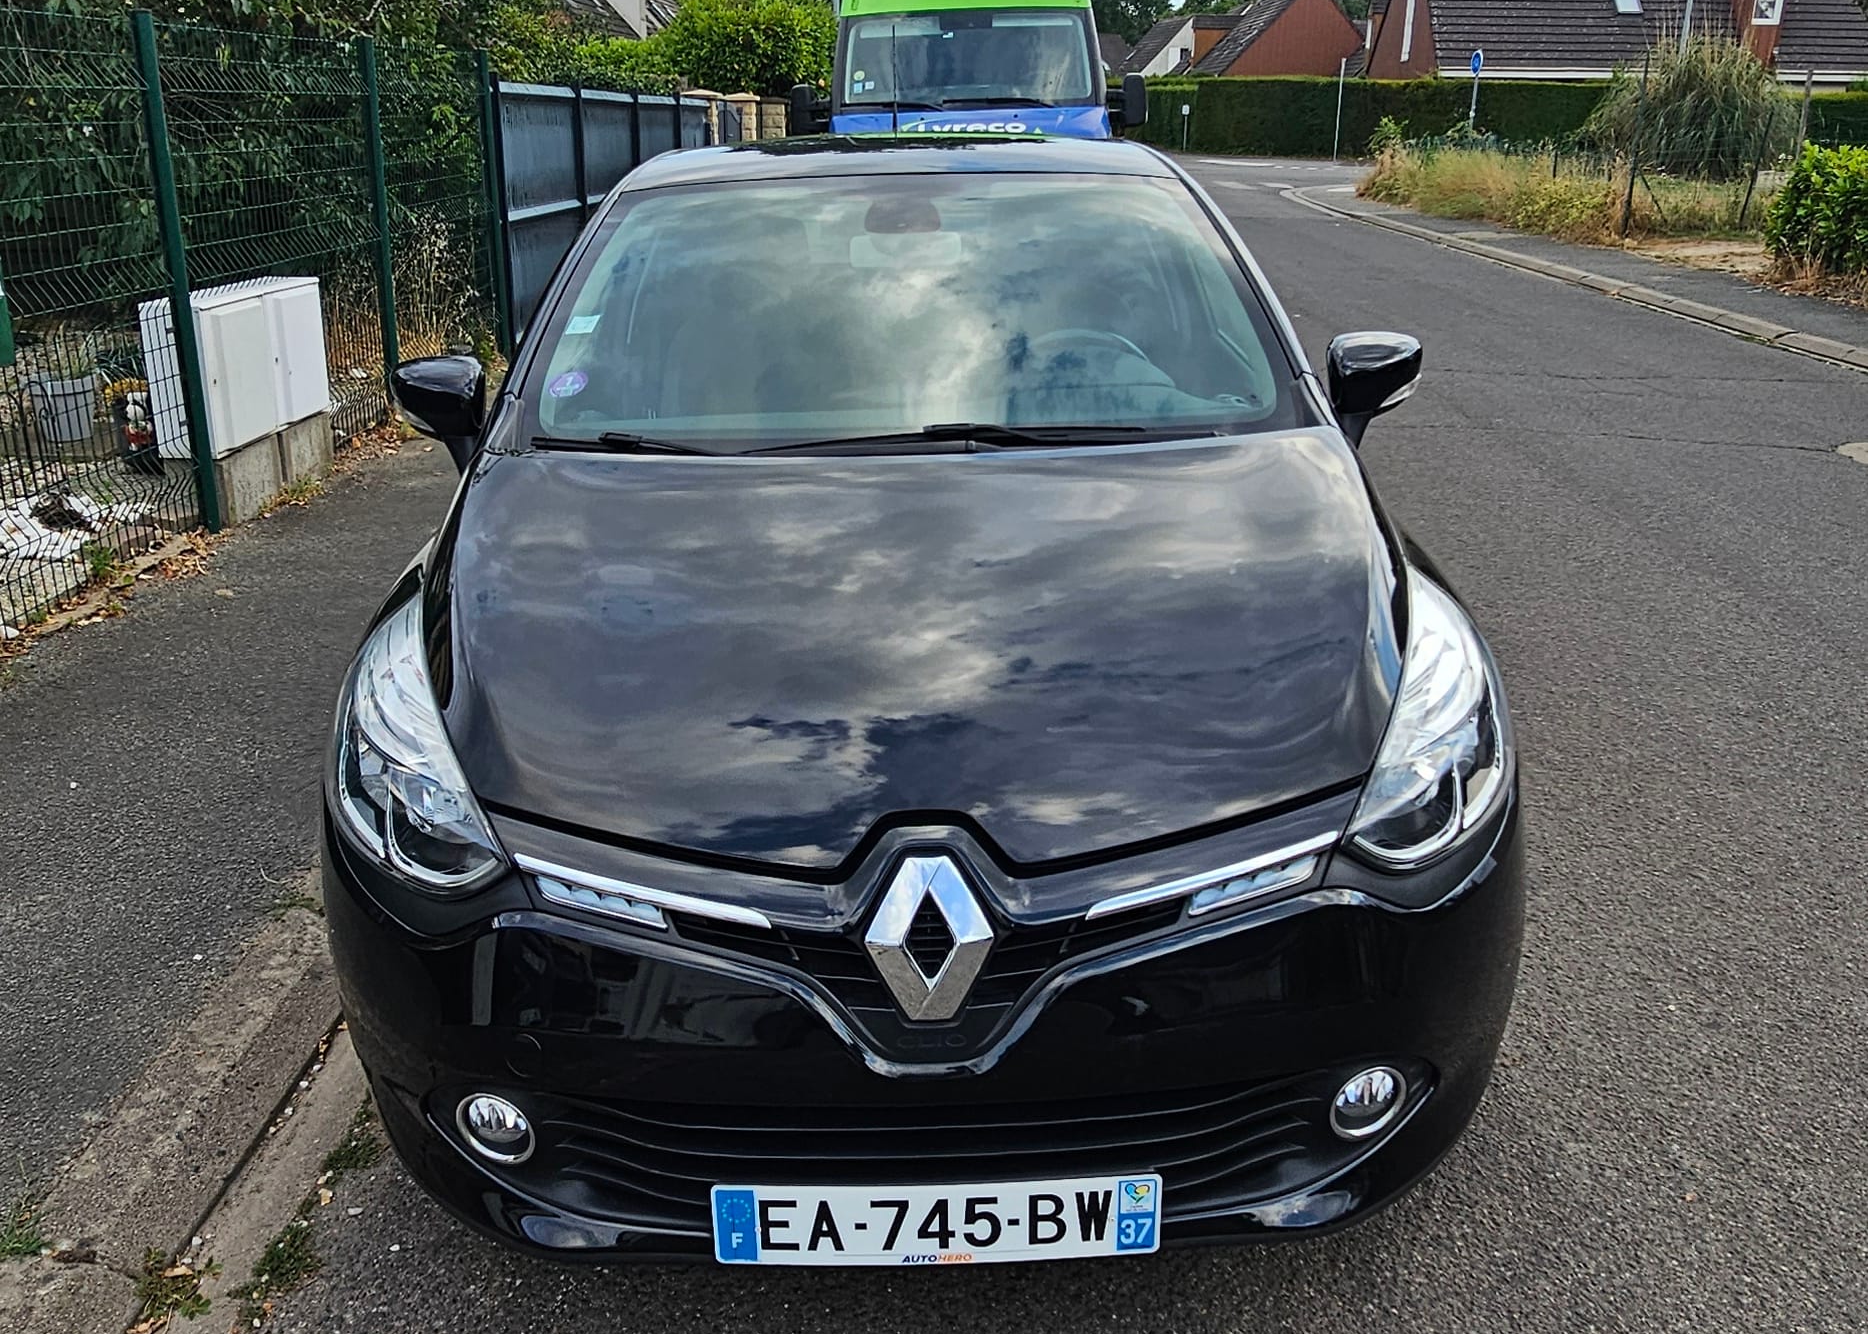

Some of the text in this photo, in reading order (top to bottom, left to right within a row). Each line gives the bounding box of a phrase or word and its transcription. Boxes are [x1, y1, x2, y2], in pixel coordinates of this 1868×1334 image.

[896, 1034, 968, 1049] CLIO
[758, 1189, 1113, 1252] EA-745-BW
[1120, 1218, 1153, 1244] 37
[731, 1233, 743, 1248] F
[902, 1254, 972, 1263] AUTOHERO
